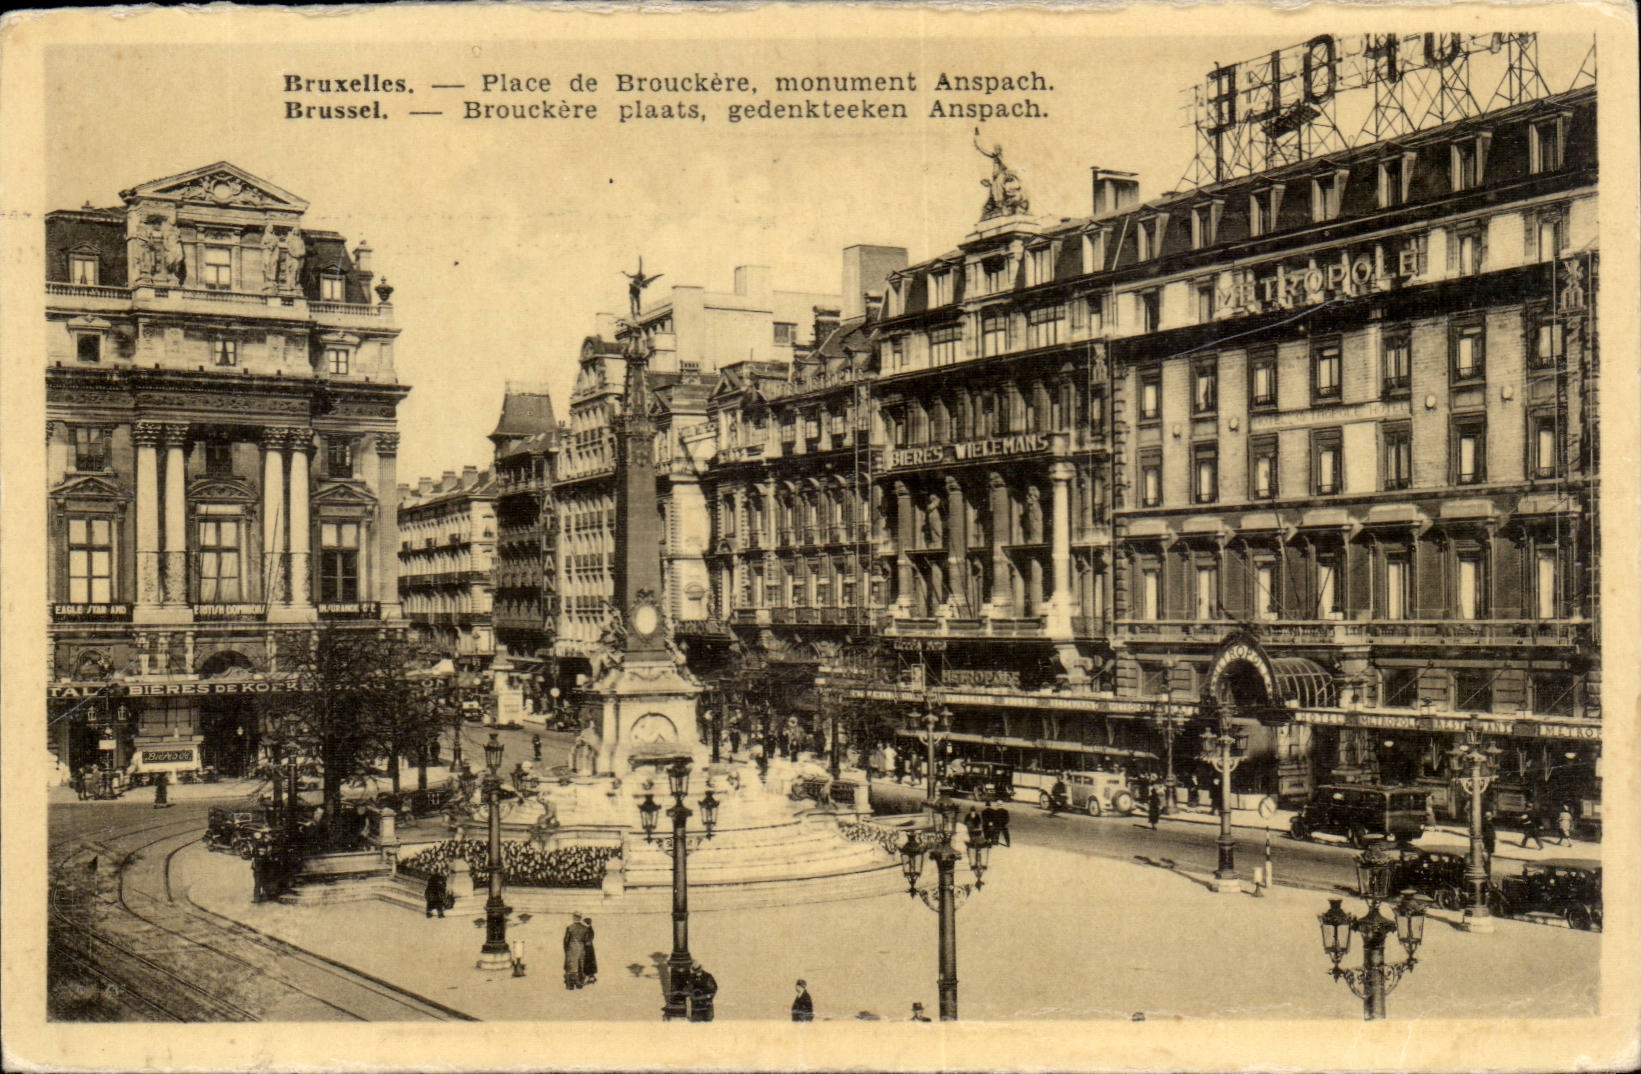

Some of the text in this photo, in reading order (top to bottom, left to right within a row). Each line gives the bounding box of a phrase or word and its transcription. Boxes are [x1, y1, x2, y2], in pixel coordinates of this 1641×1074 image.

[892, 435, 1049, 466] BIERES WIELEMANS
[543, 494, 556, 633] ATLANTA
[55, 605, 83, 615] EAGLE
[129, 685, 209, 696] BIERES
[215, 684, 237, 693] DE
